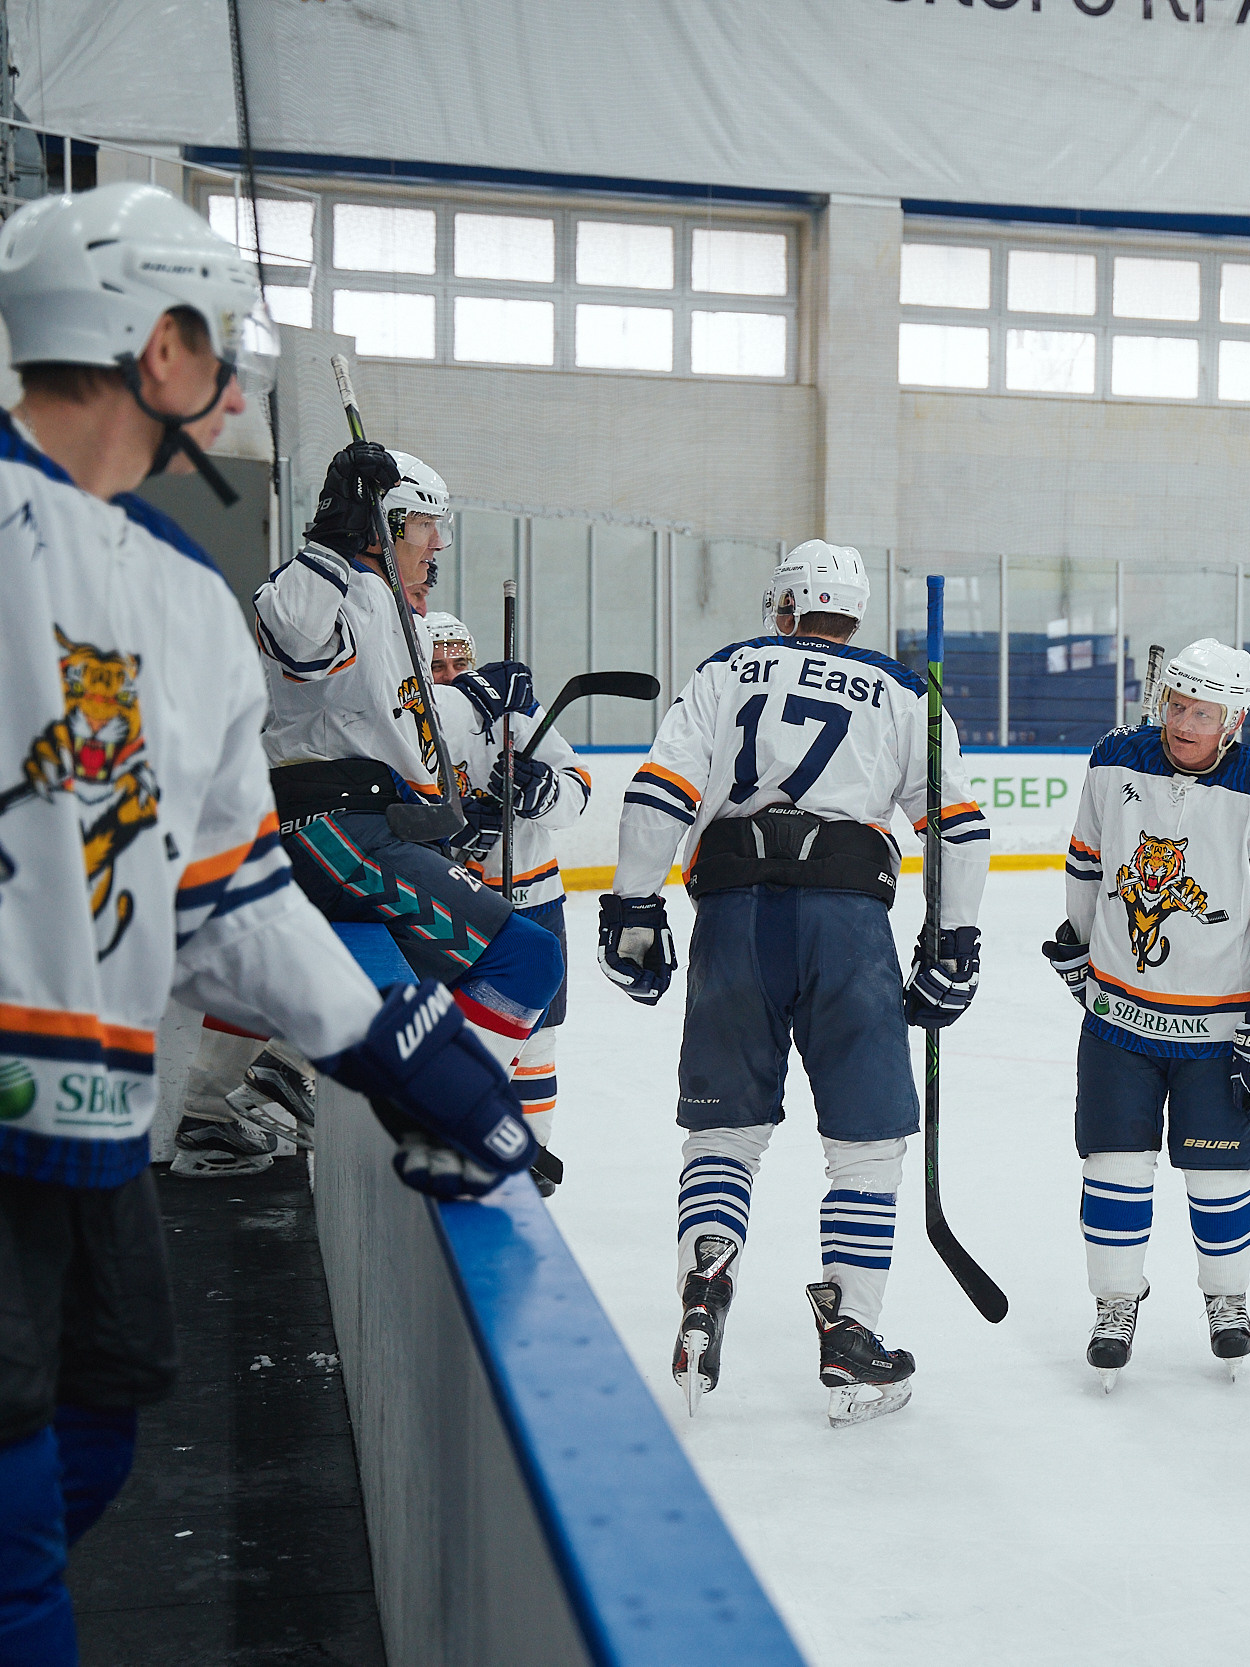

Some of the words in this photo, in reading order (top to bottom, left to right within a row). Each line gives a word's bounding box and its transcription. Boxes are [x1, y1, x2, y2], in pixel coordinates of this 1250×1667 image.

[798, 657, 885, 709] East
[728, 693, 853, 804] 17
[970, 777, 1068, 808] СБЕР
[1112, 1001, 1210, 1034] SBERBANK
[1183, 1138, 1241, 1150] BAUER
